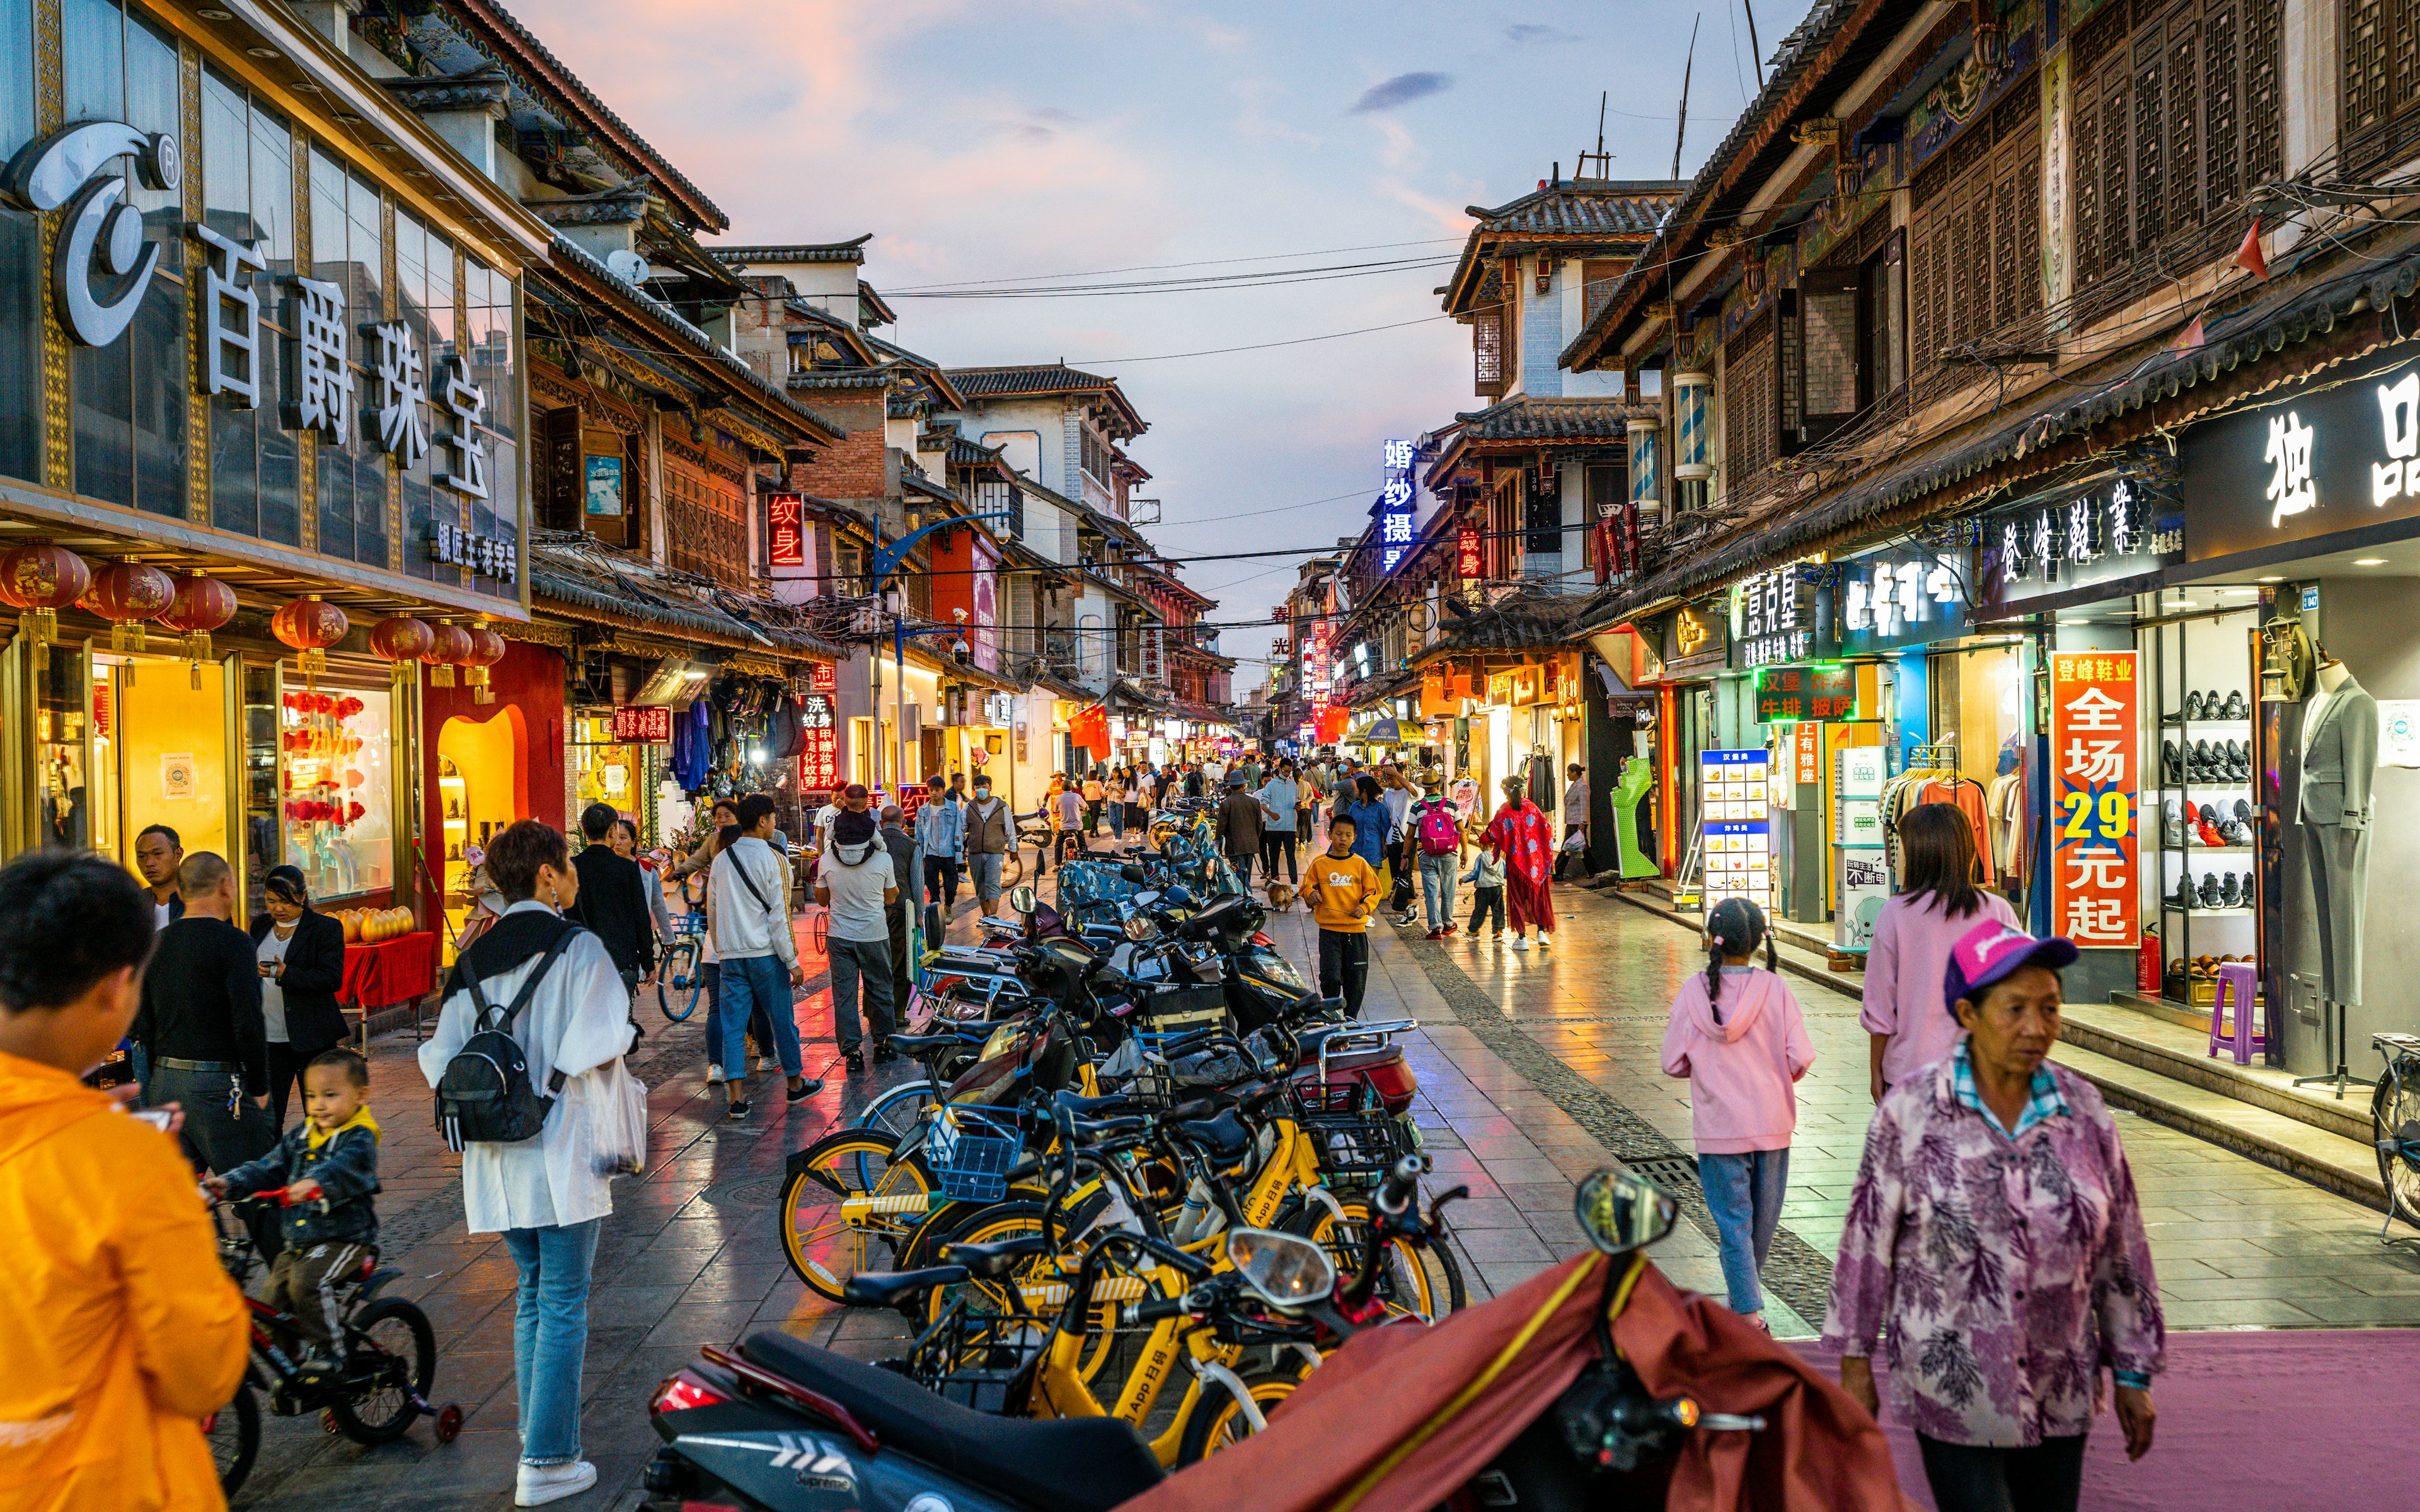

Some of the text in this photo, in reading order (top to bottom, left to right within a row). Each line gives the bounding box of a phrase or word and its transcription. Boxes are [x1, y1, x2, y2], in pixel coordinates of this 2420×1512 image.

[197, 224, 489, 500] 百爵珠宝
[771, 495, 800, 556] 纹身
[1460, 531, 1480, 574] 纹身
[2308, 596, 2317, 607] 047
[1273, 607, 1288, 655] 春光
[1761, 670, 1852, 692] 汉堡 炸鸡
[2058, 658, 2133, 682] 登峰鞋业
[1761, 695, 1853, 719] 牛排 披萨
[1722, 753, 1748, 761] 汉堡类
[1847, 860, 1872, 871] 玩转生活
[1847, 868, 1884, 884] 不断电
[1255, 1202, 1270, 1223] App
[1130, 1382, 1150, 1413] App
[1144, 1350, 1167, 1382] 扫码
